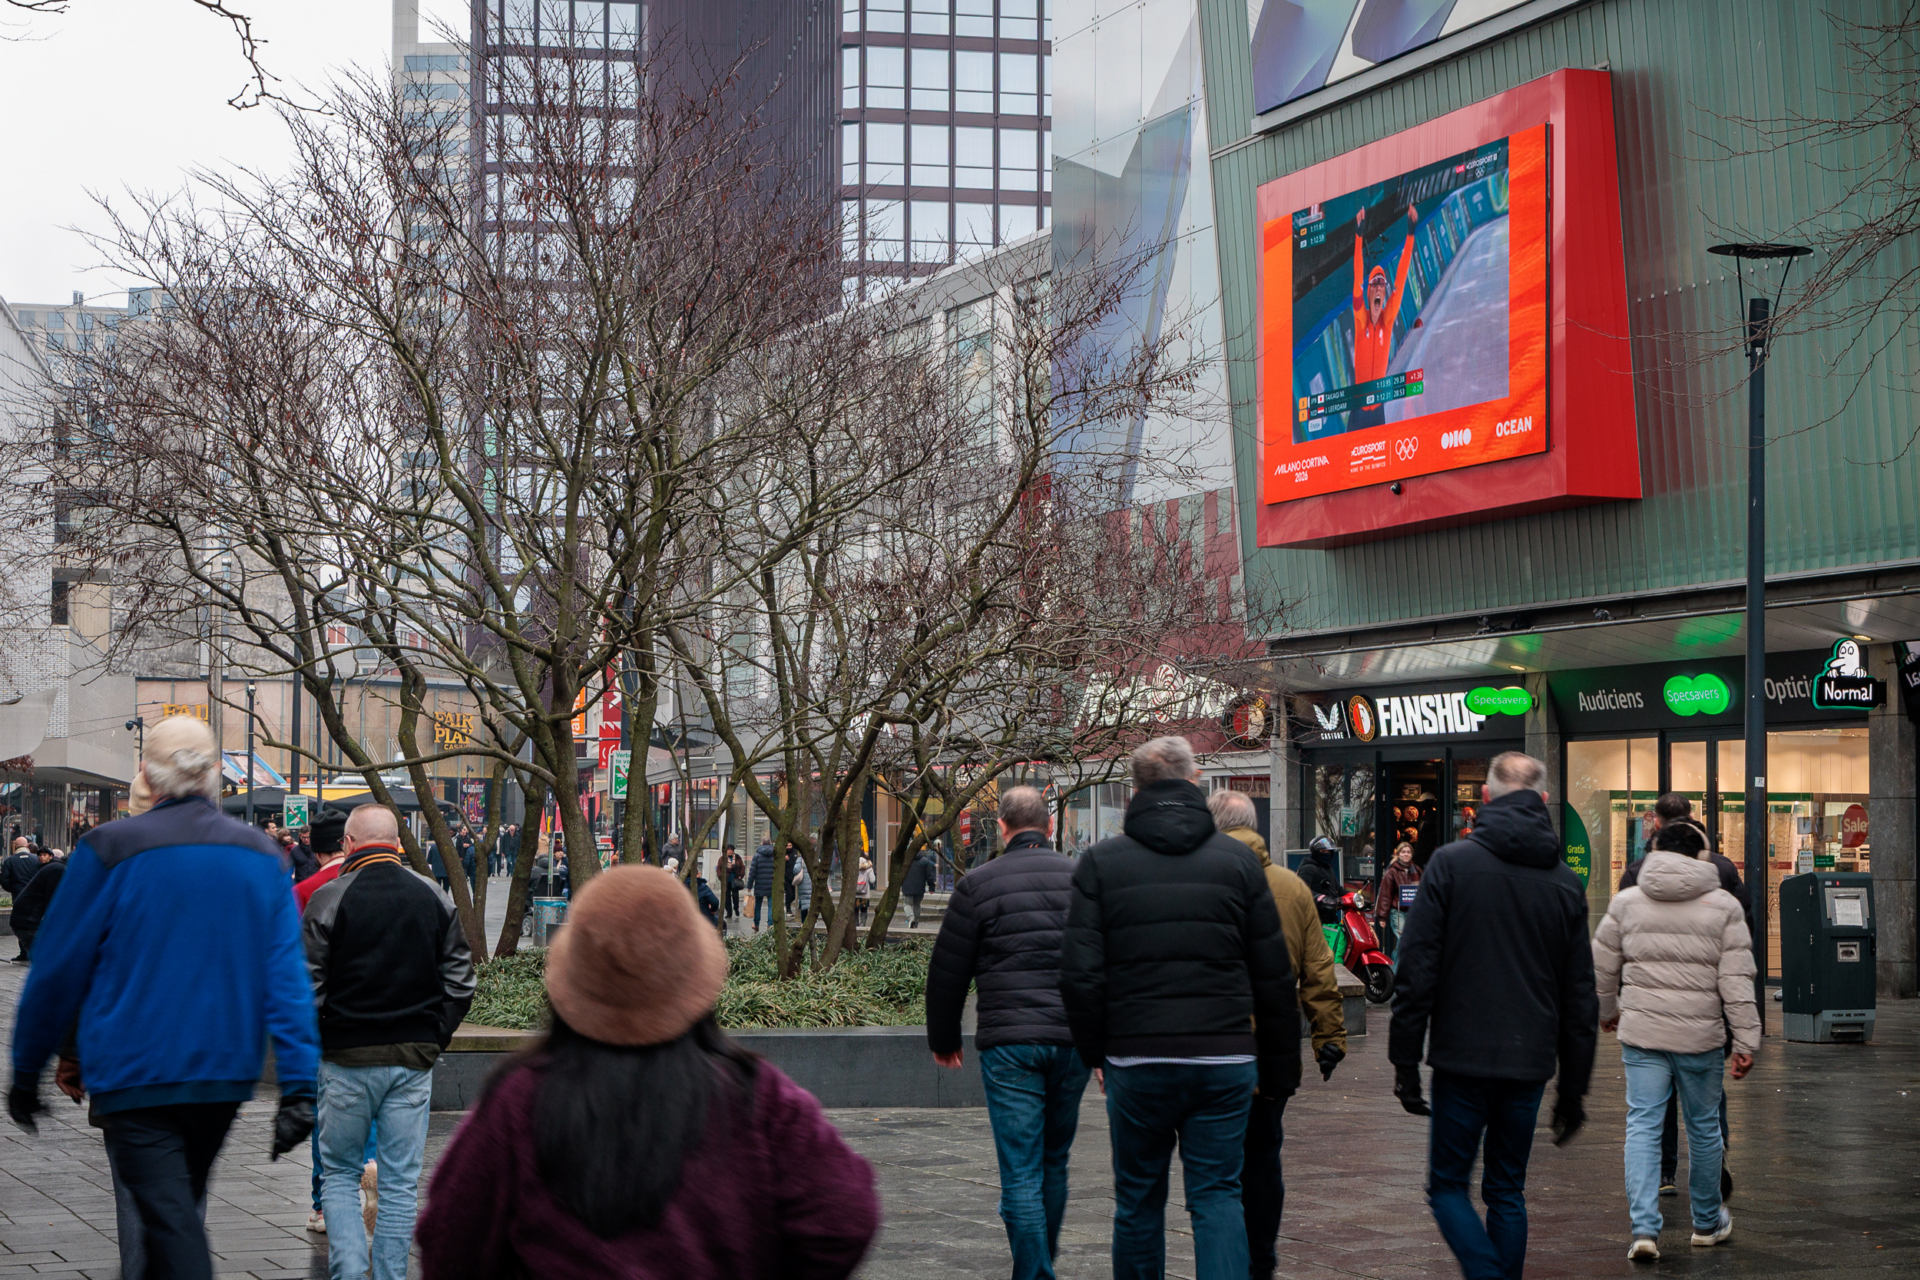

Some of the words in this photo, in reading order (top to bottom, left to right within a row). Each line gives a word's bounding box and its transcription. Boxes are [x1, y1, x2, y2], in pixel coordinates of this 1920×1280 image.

[1328, 402, 1347, 413] LEERDAM
[1496, 416, 1532, 437] OCEAN
[1350, 441, 1386, 457] EUROSPORT
[1274, 459, 1301, 476] MILANO
[1301, 455, 1330, 470] CORTINA
[1294, 471, 1308, 483] 2026
[1666, 688, 1720, 705] Specsavers
[1824, 681, 1873, 701] Normal
[1474, 695, 1528, 706] Specsavers
[1578, 688, 1644, 712] Audiciens
[434, 711, 474, 728] FAIR
[1843, 817, 1868, 832] Sale
[1567, 844, 1585, 854] Gratis
[1567, 856, 1581, 866] oog-
[1571, 864, 1588, 876] eting
